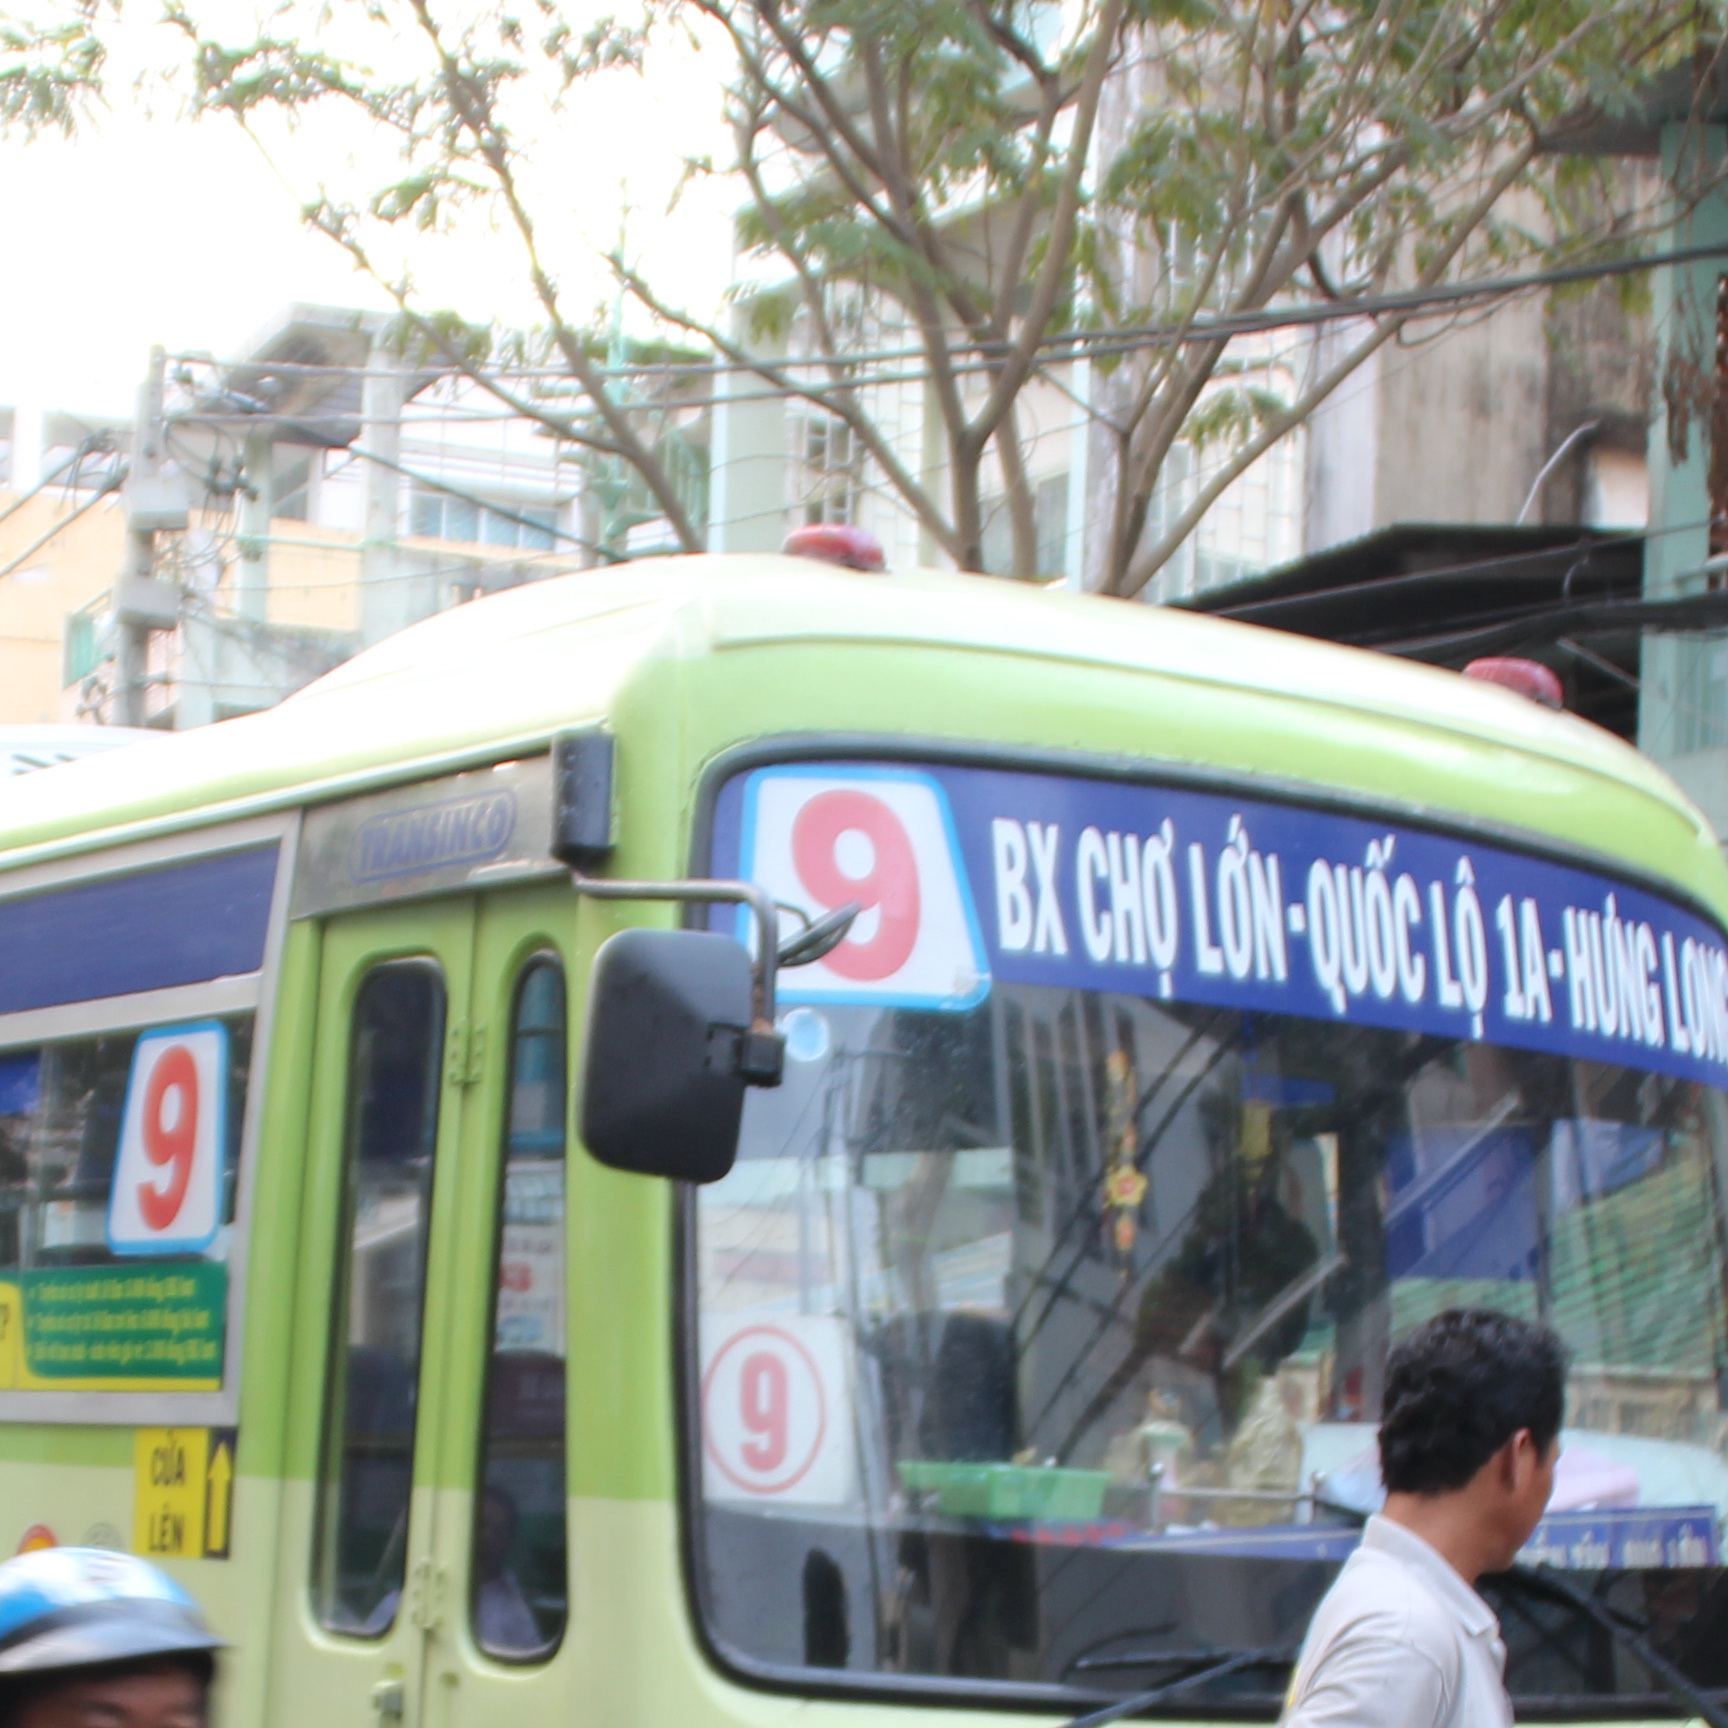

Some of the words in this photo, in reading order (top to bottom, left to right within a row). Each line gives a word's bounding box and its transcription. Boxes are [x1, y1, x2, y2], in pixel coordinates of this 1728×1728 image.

[792, 789, 921, 982] 9
[992, 817, 1068, 956] BX
[1076, 817, 1177, 999] CHỢ
[1429, 855, 1488, 1040] LỘ
[135, 1044, 200, 1231] 9
[740, 1352, 788, 1469] 9
[148, 1501, 186, 1553] LÊN
